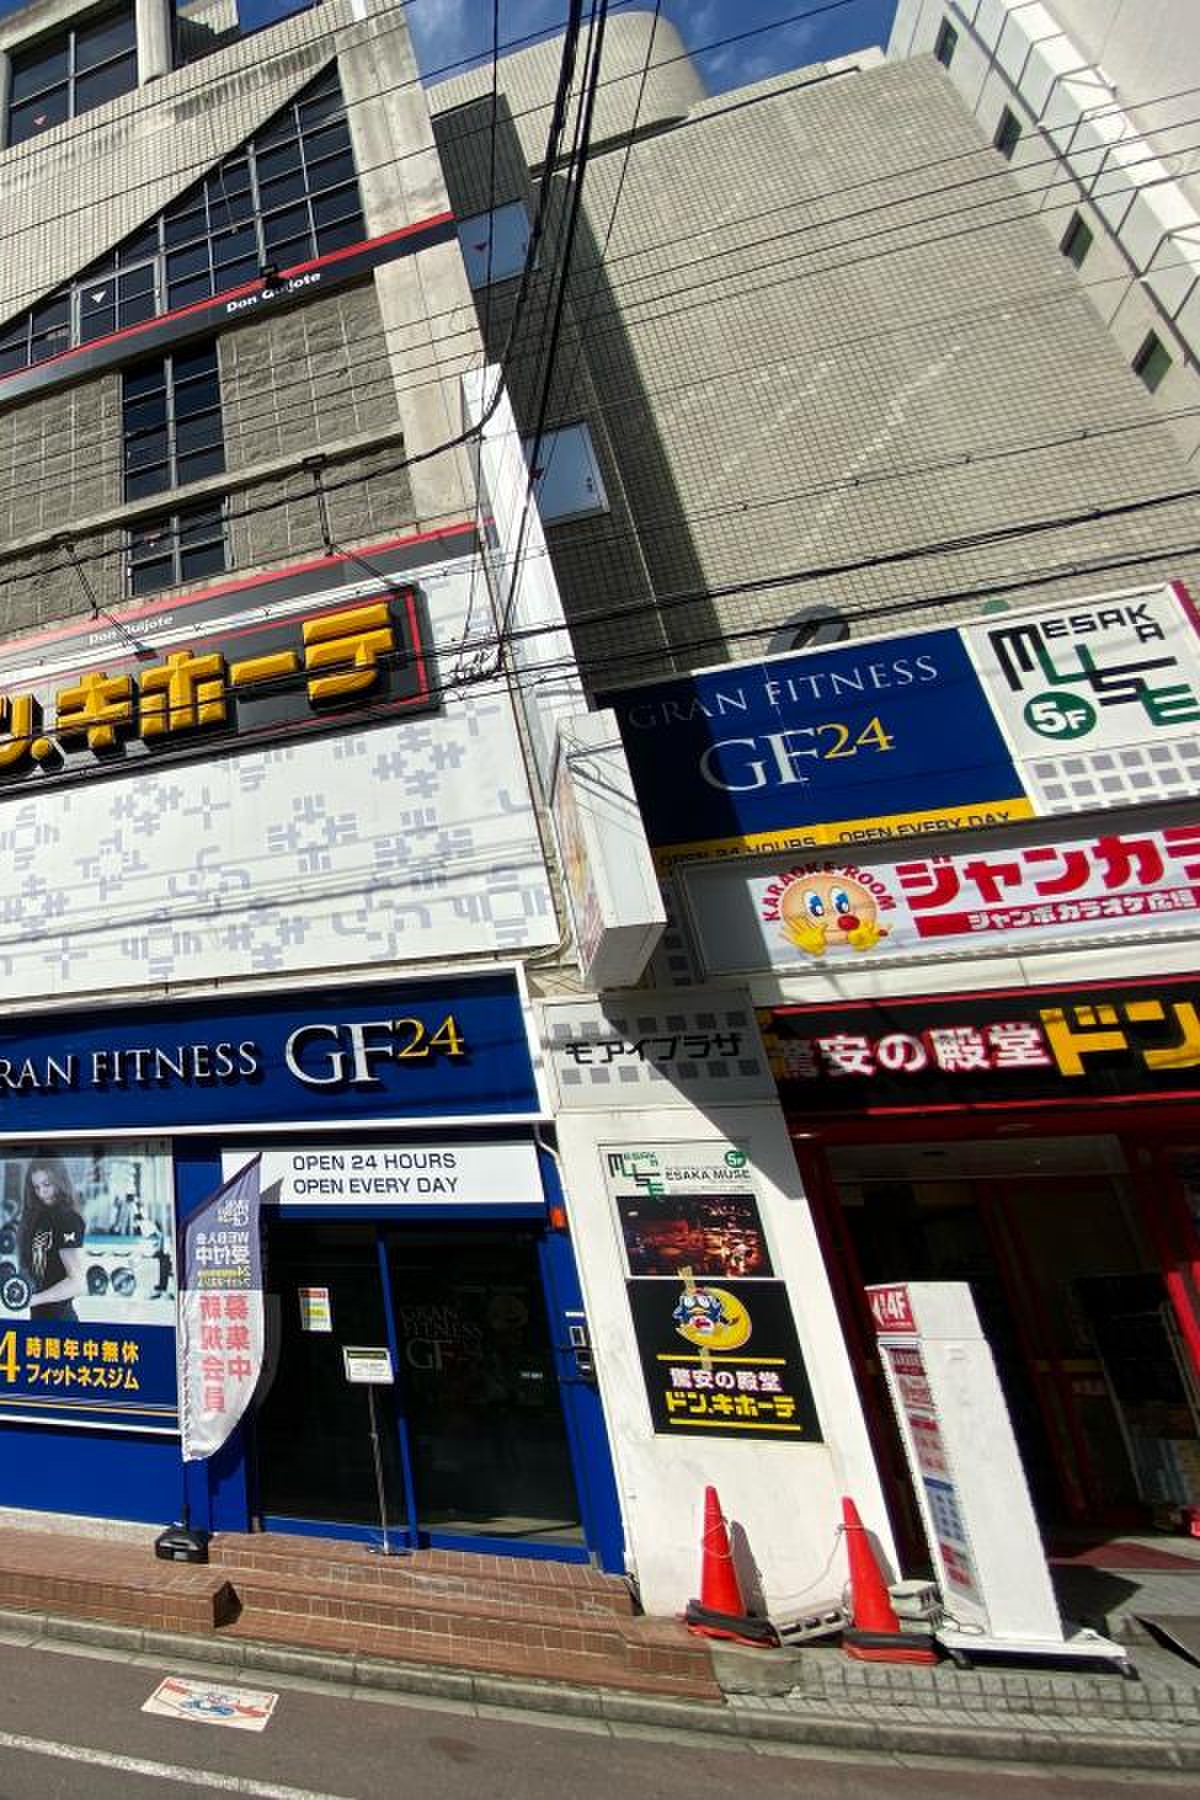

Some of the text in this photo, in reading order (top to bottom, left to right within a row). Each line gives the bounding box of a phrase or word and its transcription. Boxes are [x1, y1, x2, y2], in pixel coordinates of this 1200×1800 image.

[227, 272, 321, 313] Don Qjote
[628, 654, 940, 729] GRAN FITNESS
[1029, 700, 1087, 733] 5F
[701, 716, 897, 792] GF24
[91, 1041, 258, 1084] FITNESS
[285, 1014, 465, 1084] GF24
[292, 1153, 458, 1171] OPEN 24 HOURS
[293, 1176, 458, 1194] OPEN EVERY DAY
[25, 1336, 140, 1364] 時間年中無休
[25, 1362, 140, 1391] フィットネスジム
[668, 1367, 783, 1393] 驚安の殿堂
